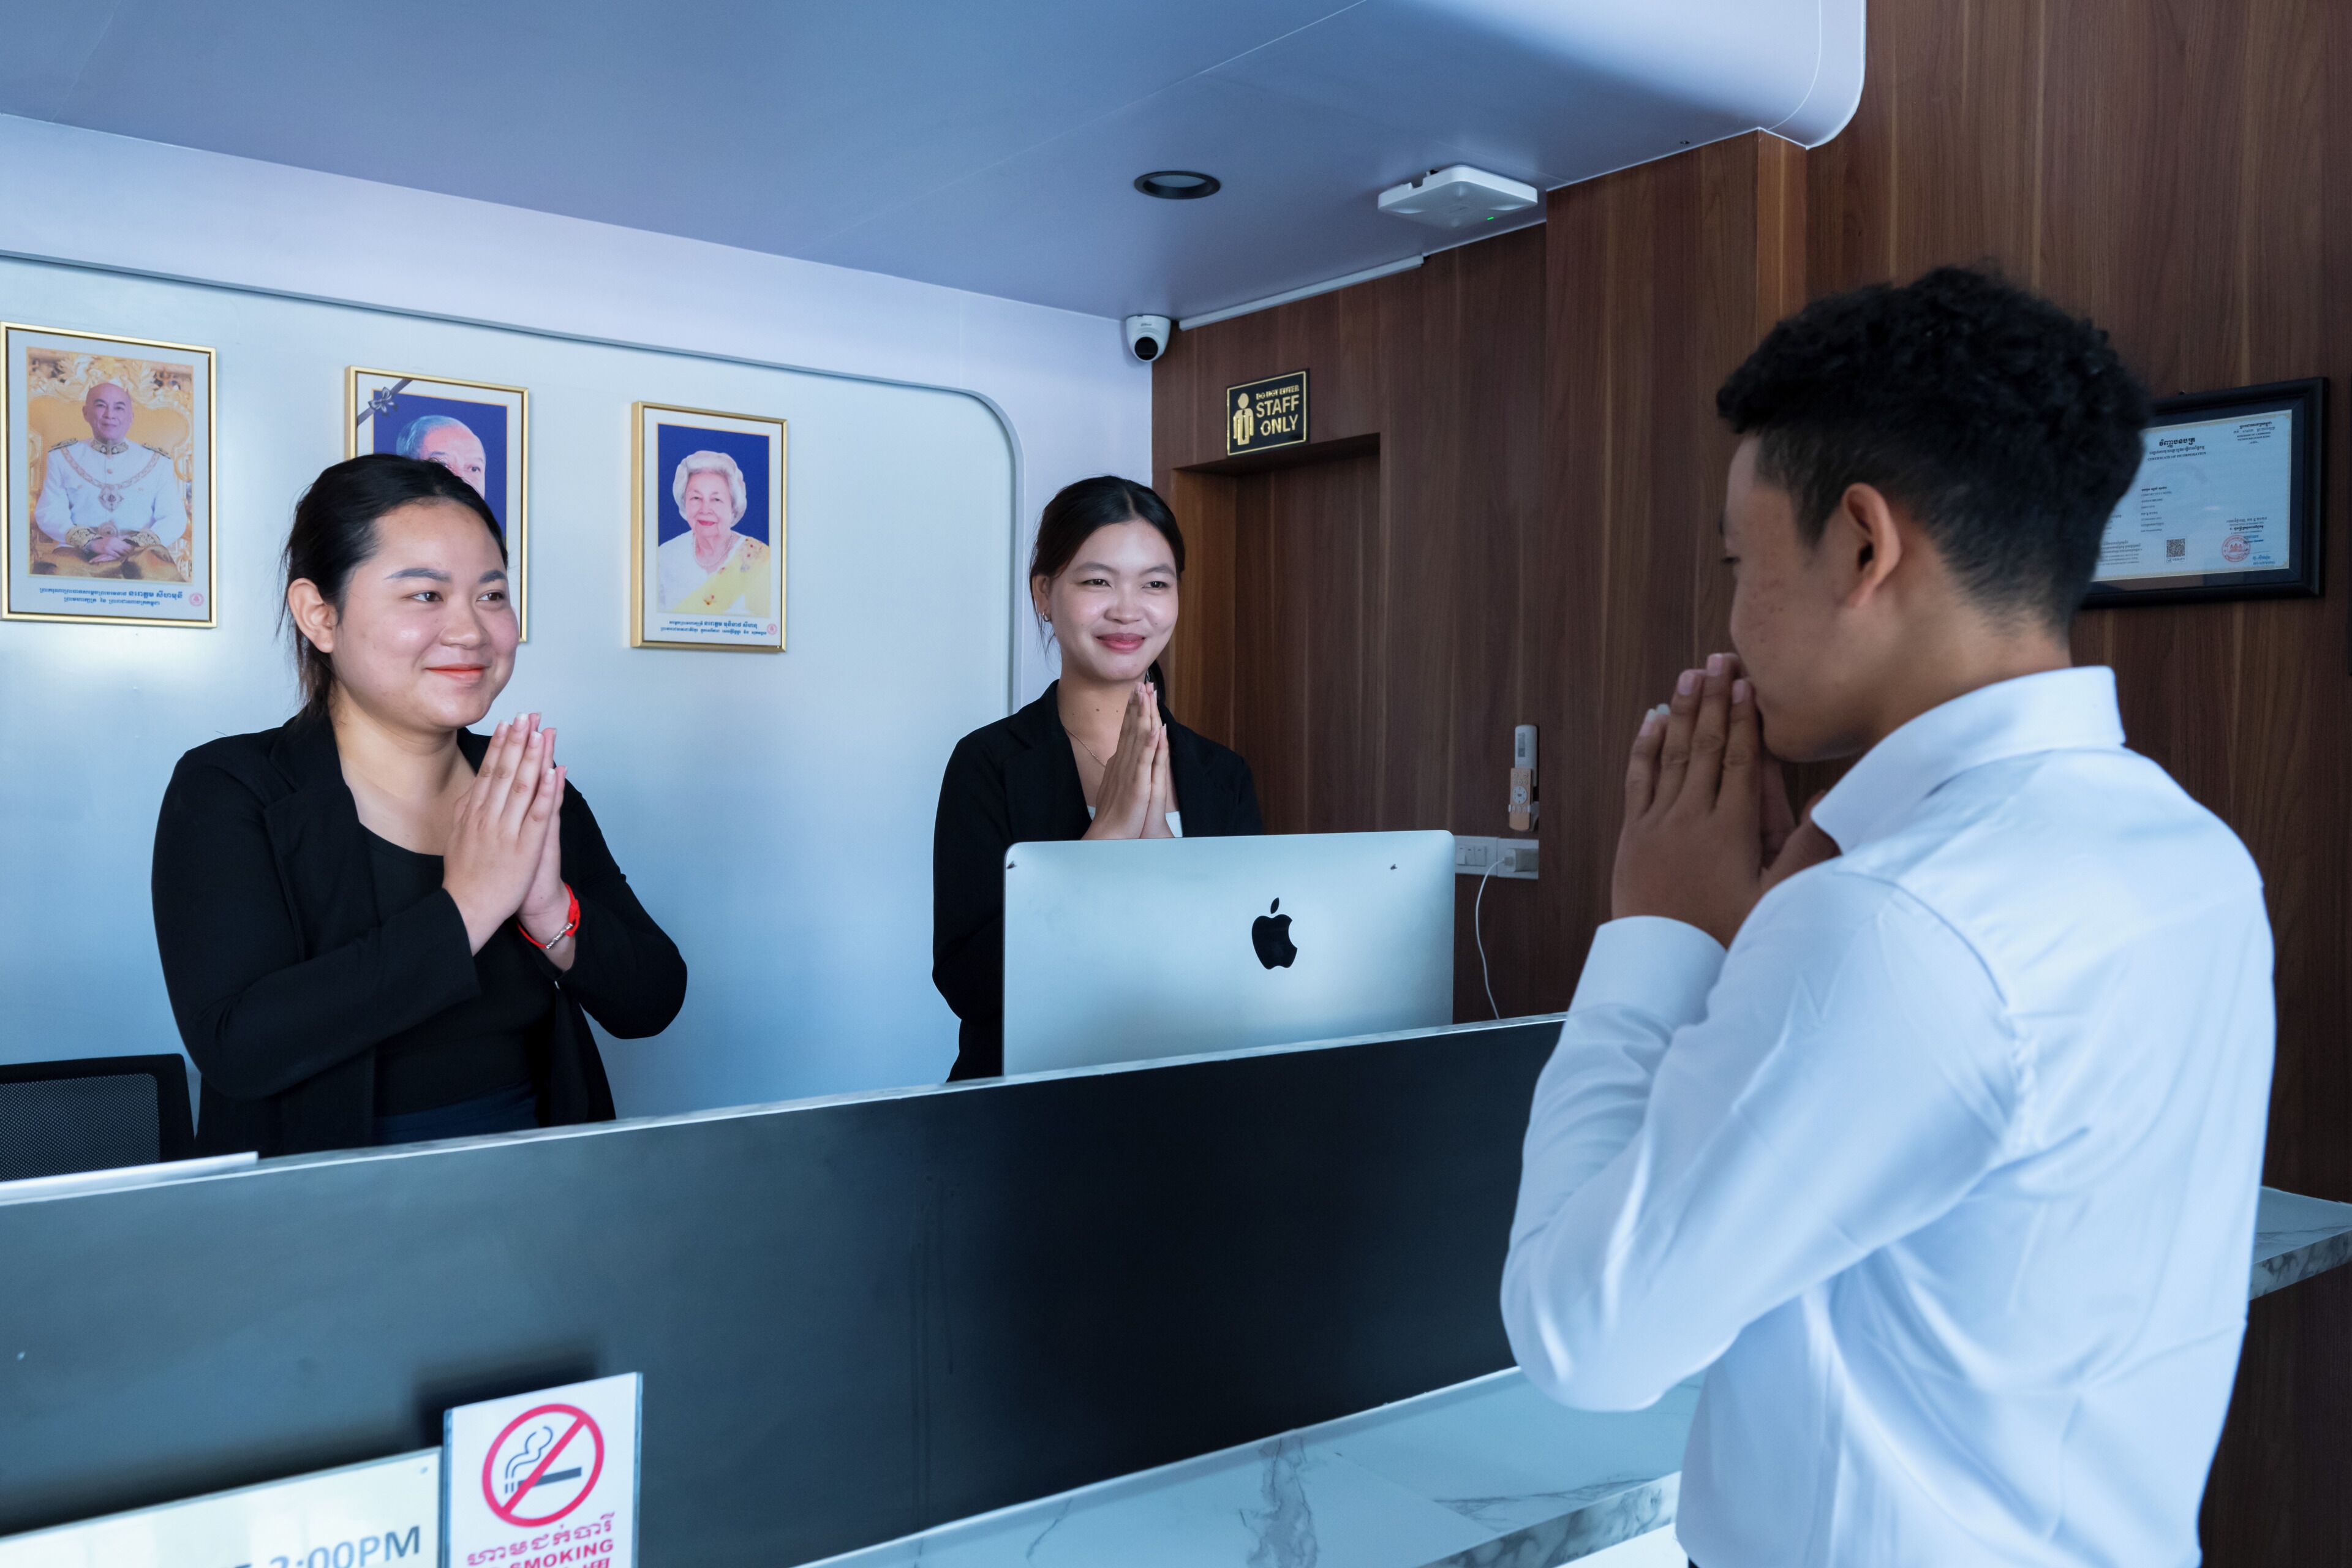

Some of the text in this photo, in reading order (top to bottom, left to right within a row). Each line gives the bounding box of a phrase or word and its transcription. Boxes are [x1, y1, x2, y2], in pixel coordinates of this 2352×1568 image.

[1256, 394, 1299, 418] STAFF
[1260, 414, 1298, 436] ONLY
[510, 1538, 614, 1568] SMOKING
